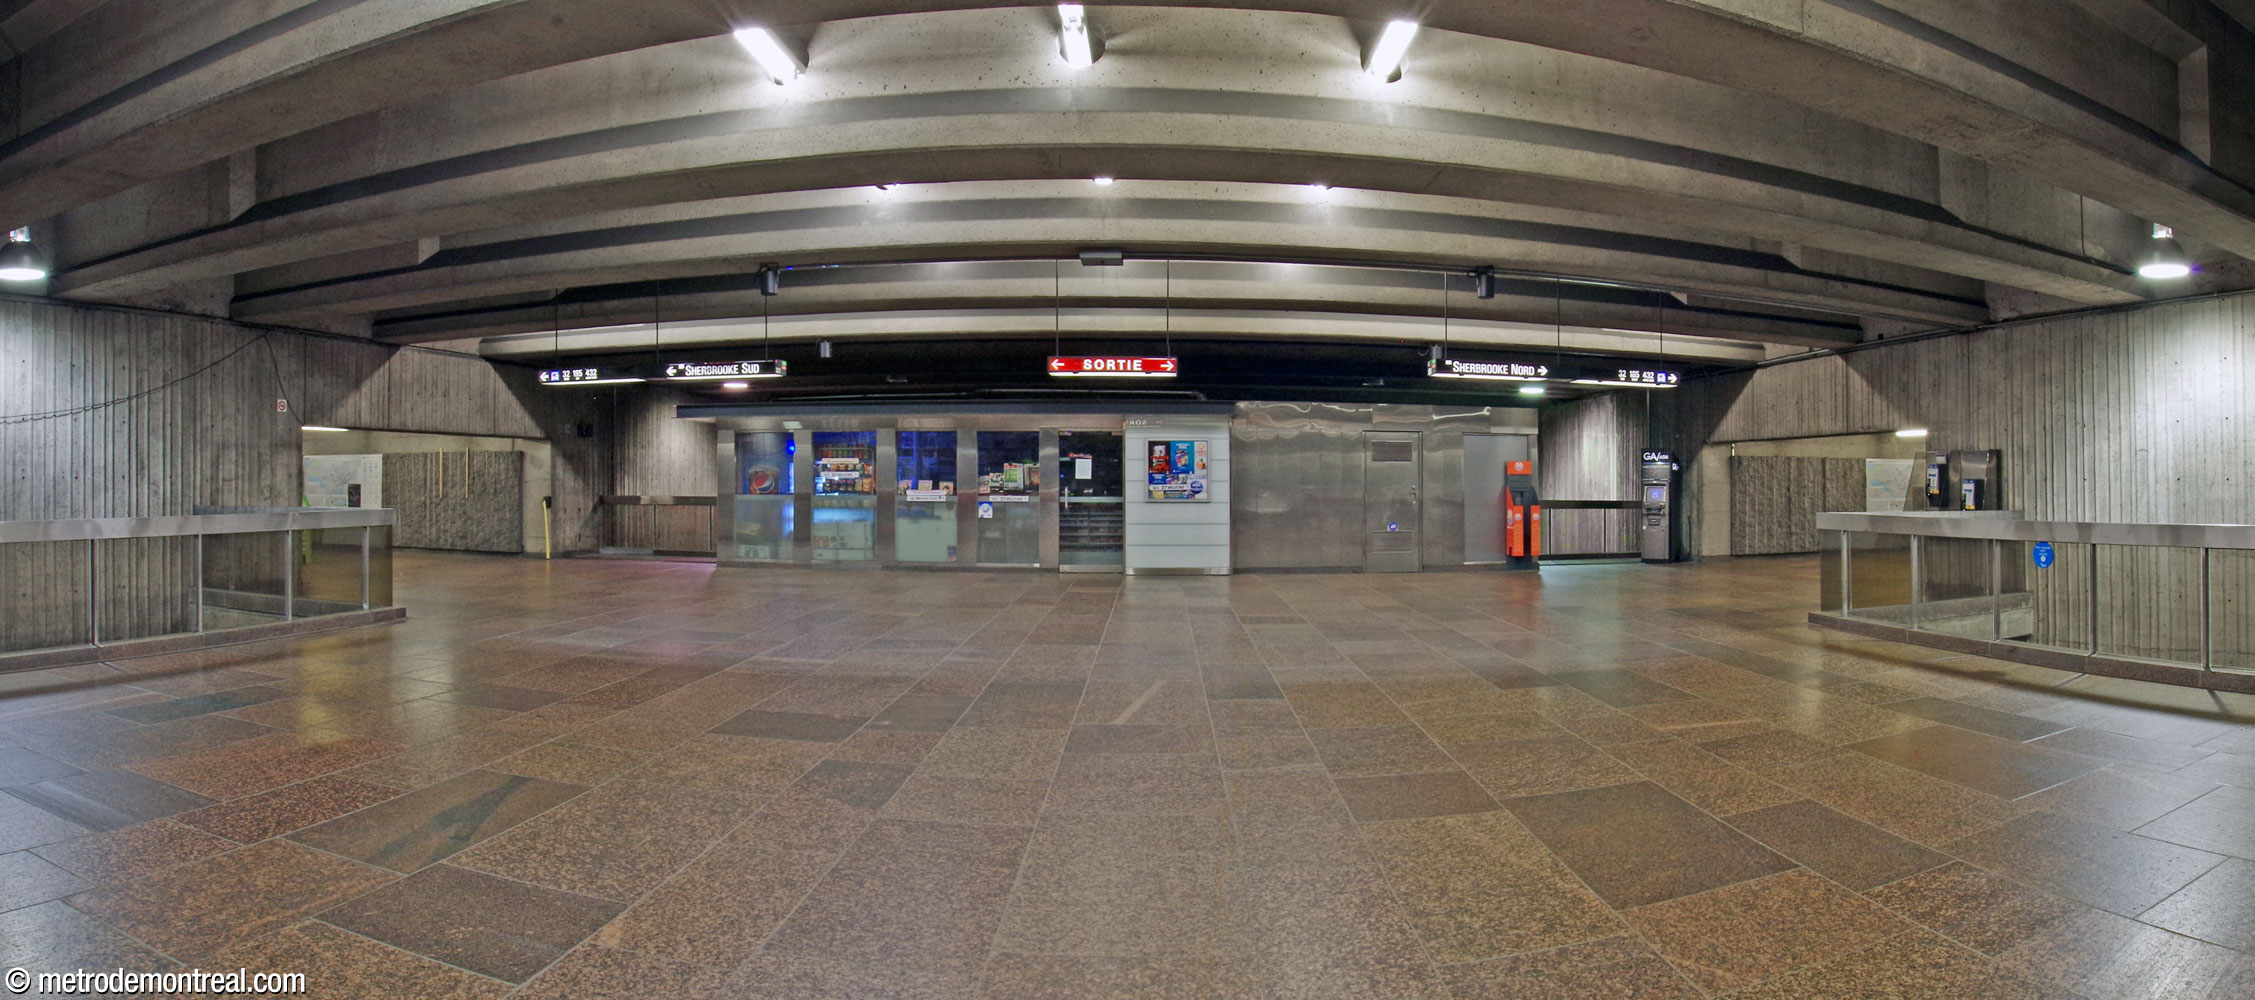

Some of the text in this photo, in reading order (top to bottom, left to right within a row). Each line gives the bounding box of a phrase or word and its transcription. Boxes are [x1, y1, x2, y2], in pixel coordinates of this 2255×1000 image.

[1083, 359, 1142, 370] SORTIE
[562, 370, 570, 378] 32
[585, 368, 597, 376] 432
[1618, 369, 1627, 378] 32
[1642, 371, 1655, 379] 432
